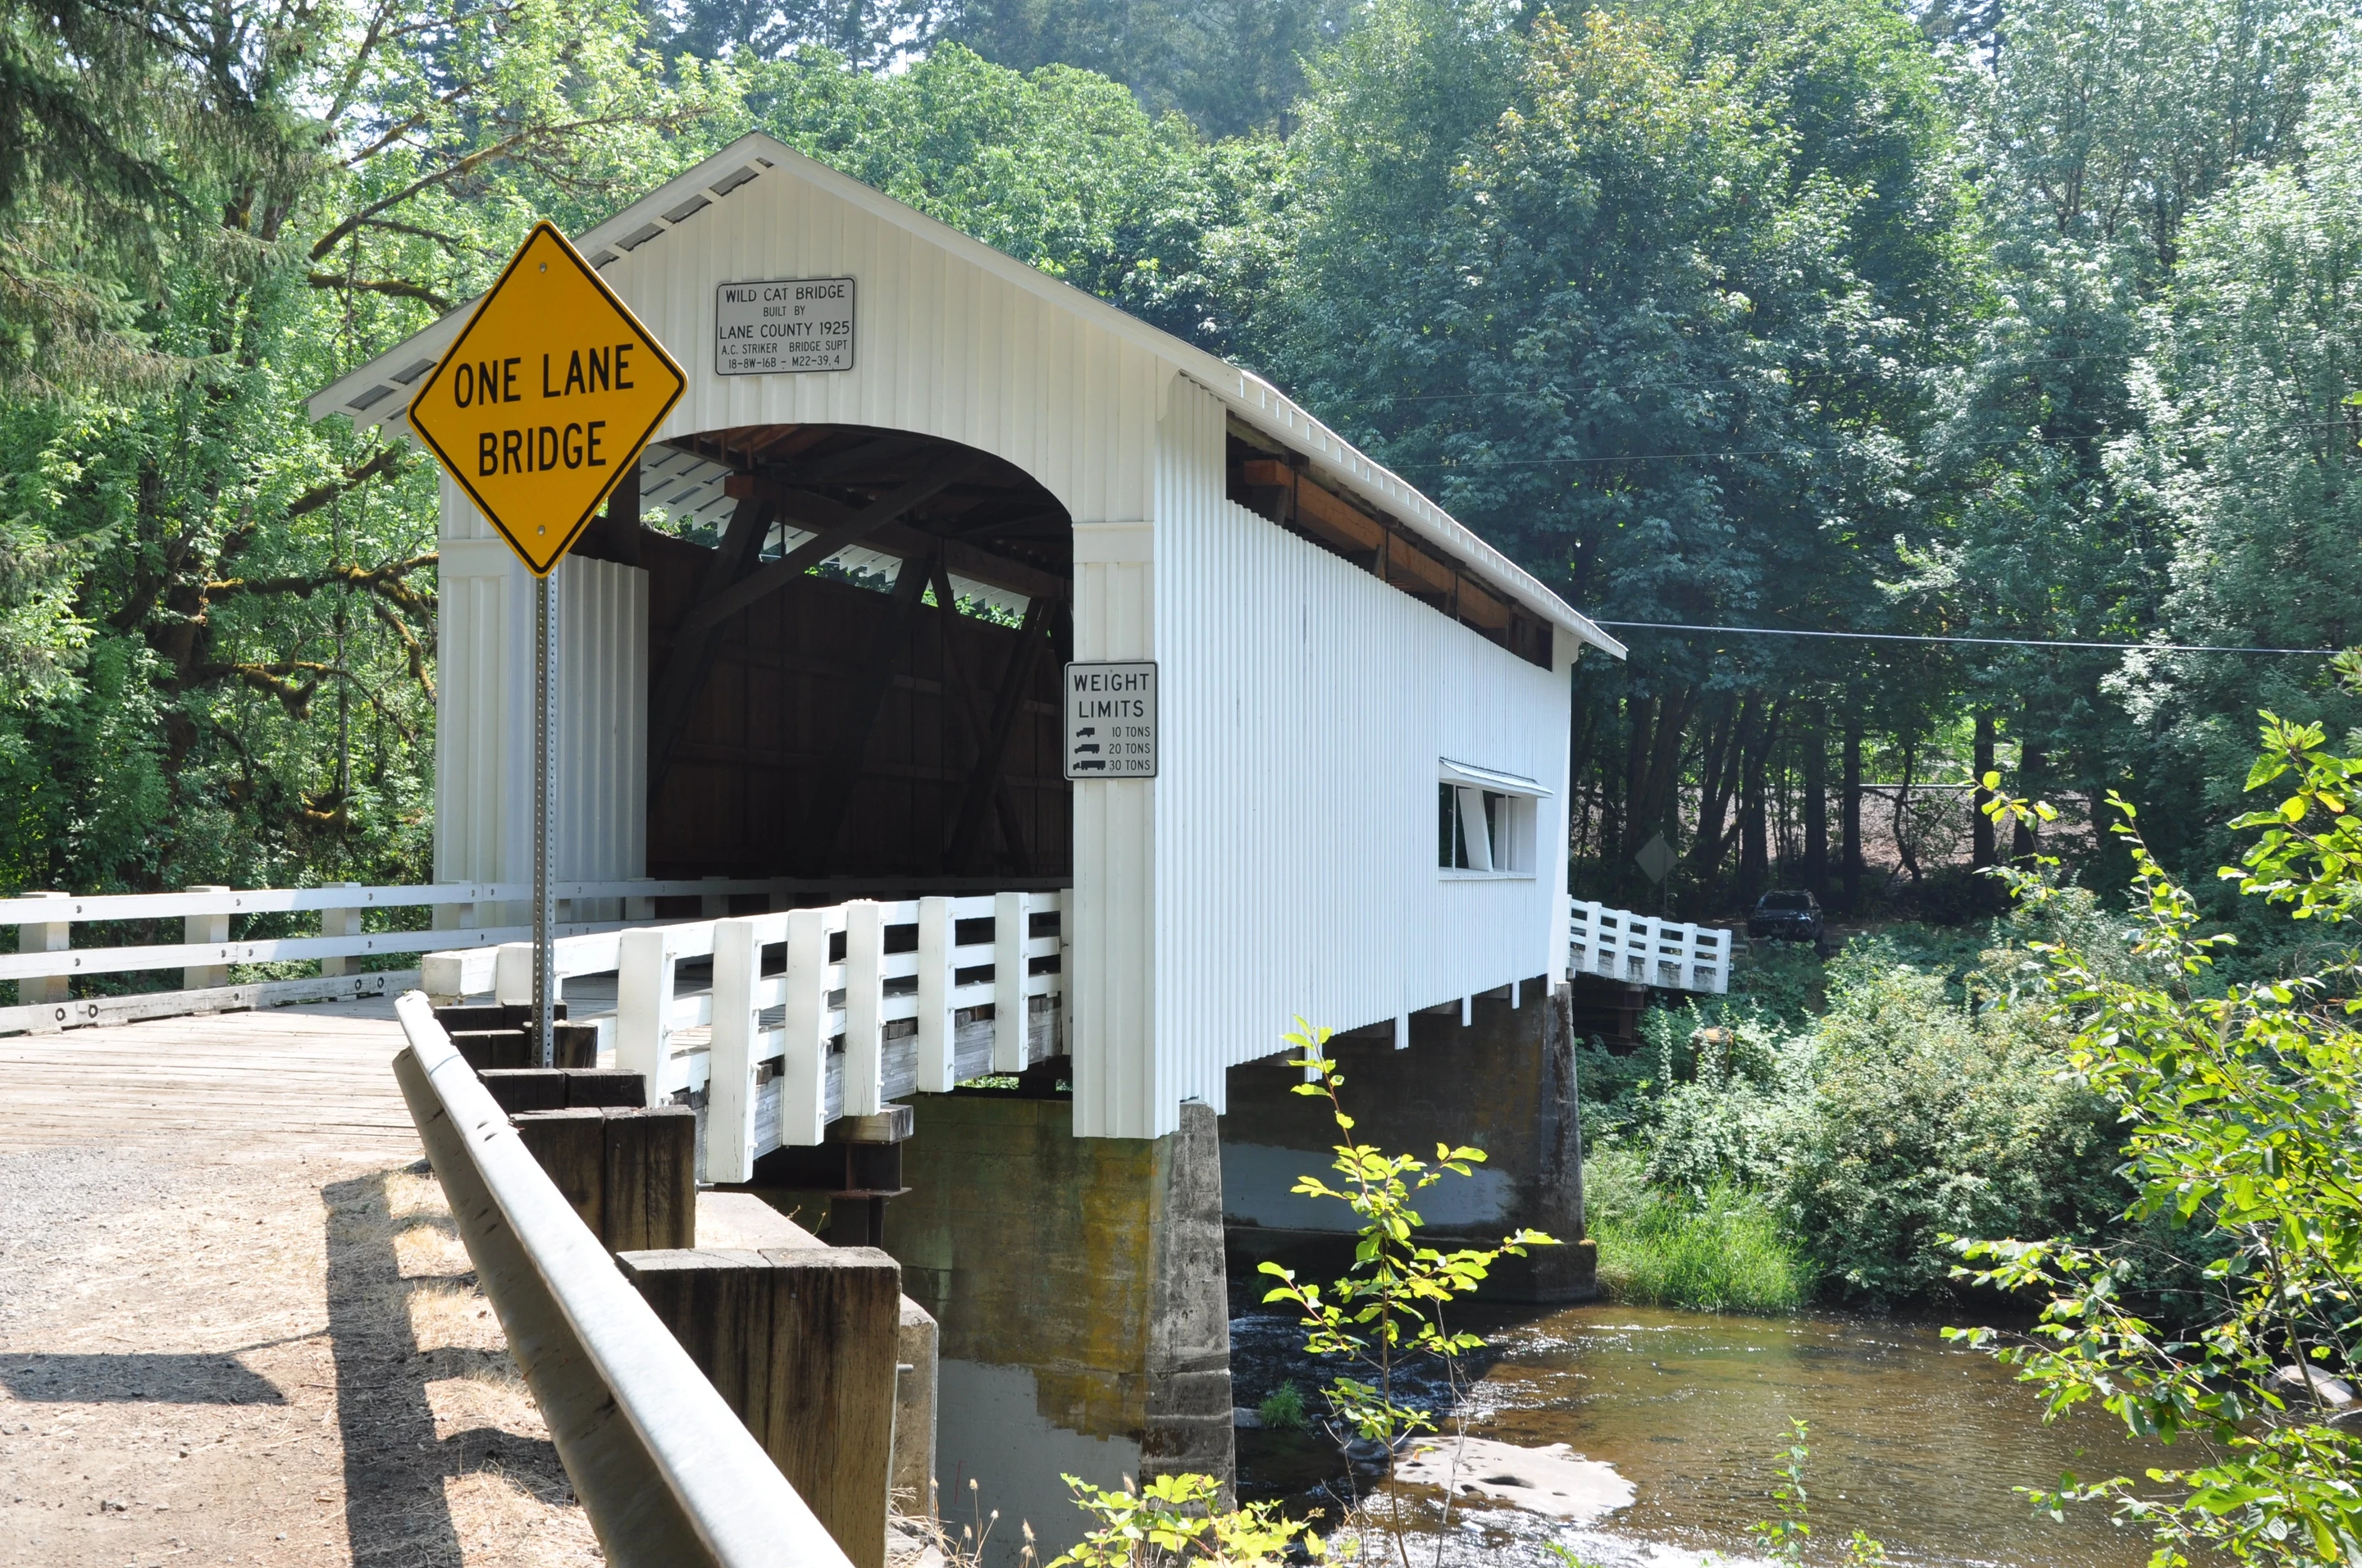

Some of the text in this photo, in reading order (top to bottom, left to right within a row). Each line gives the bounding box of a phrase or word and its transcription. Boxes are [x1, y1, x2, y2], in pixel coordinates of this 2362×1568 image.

[726, 285, 845, 303] WILD CAT BRIDGE
[763, 305, 805, 317] BUILT BY
[719, 321, 850, 340] LANE COUNTY 1925
[722, 340, 847, 355] A.C. STRIKER BRIDGE SUPT
[454, 344, 634, 409] ONE LANE
[478, 421, 607, 477] BRIDGE
[1074, 673, 1149, 691] WEIGHT
[1078, 700, 1144, 718] LIMITS
[1111, 726, 1151, 737] 10 TONS
[1109, 743, 1151, 754] 20 TONS
[1109, 759, 1151, 771] 30 TONS
